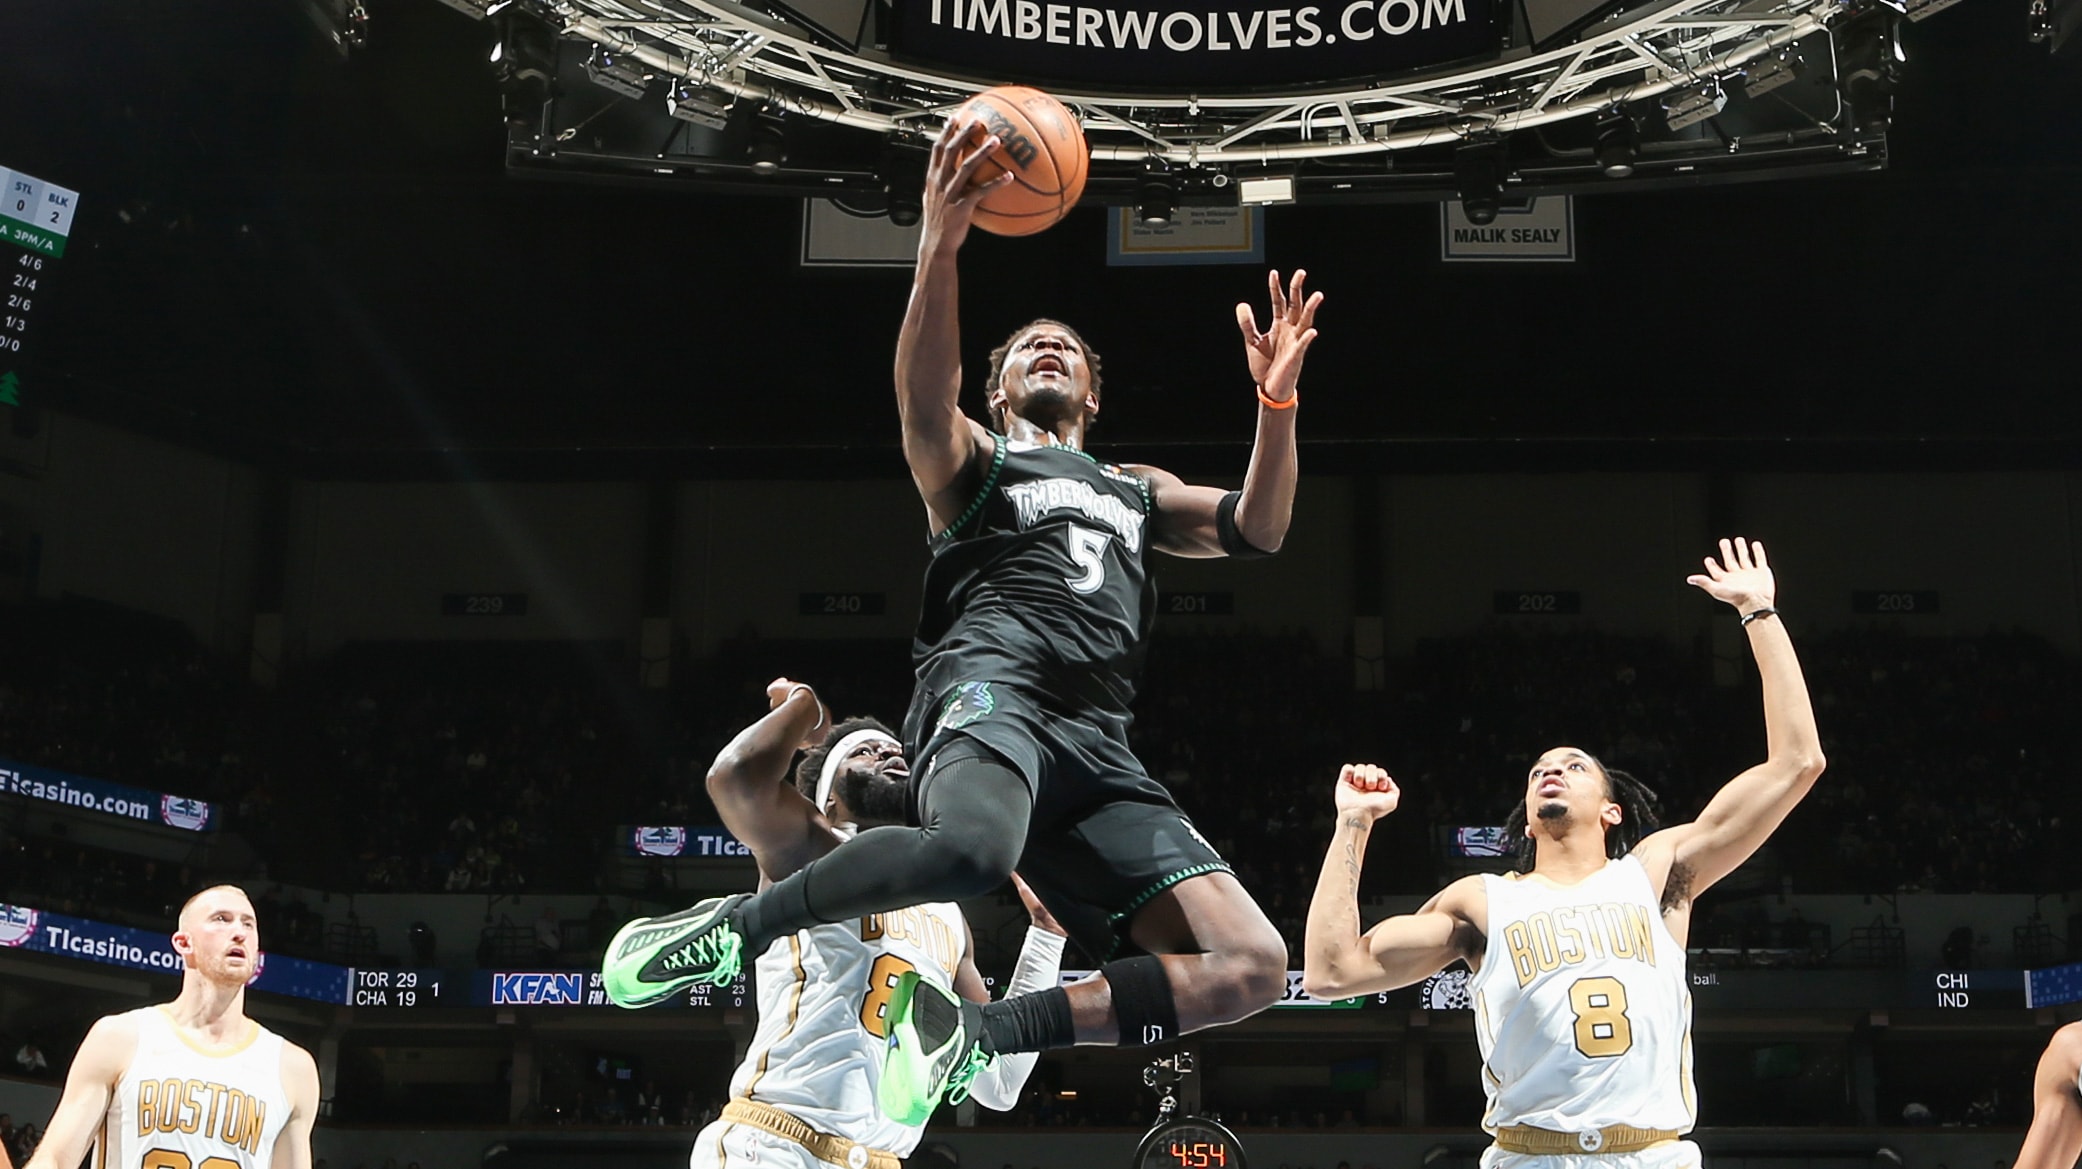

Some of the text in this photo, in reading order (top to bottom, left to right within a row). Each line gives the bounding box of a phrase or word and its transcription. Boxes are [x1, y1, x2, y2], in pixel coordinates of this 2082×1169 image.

[14, 181, 69, 208] STL BLK
[16, 200, 60, 224] 0 2
[14, 229, 53, 250] 3PM/A
[1454, 228, 1560, 243] MALIK SEALY
[19, 254, 42, 271] 4/6
[13, 274, 37, 291] 2/4
[8, 295, 31, 311] 2/6
[5, 316, 25, 332] 1/3
[1001, 478, 1146, 554] TIMBERWOLVES
[1064, 521, 1113, 595] 5
[466, 596, 504, 613] 239
[824, 595, 861, 612] 240
[1171, 595, 1206, 612] 201
[1519, 594, 1556, 611] 202
[1876, 594, 1915, 611] 203
[1504, 903, 1656, 990] BOSTON
[358, 971, 417, 988] TOR 29
[1693, 973, 1720, 985] ball.
[1936, 973, 1968, 989] CHI
[431, 982, 438, 997] 1
[492, 973, 583, 1005] KFAN
[689, 985, 745, 994] AST 23
[859, 952, 918, 1040] 8
[356, 990, 416, 1006] CHA 19
[689, 996, 742, 1007] STL 0
[1937, 993, 1969, 1008] IND
[1568, 976, 1633, 1059] 8
[138, 1078, 266, 1156] BOSTON
[1171, 1143, 1225, 1167] 4:54
